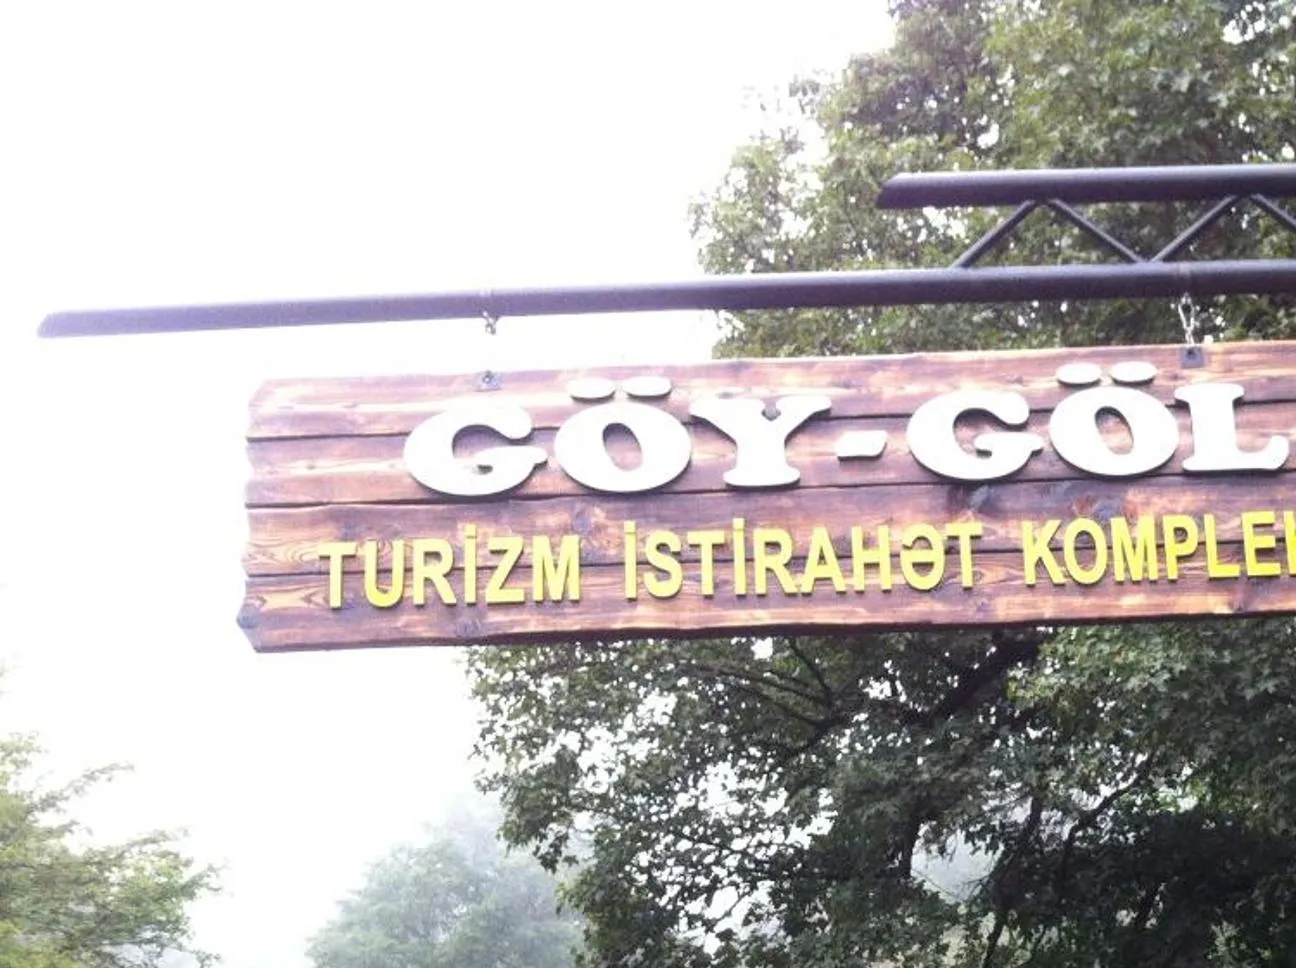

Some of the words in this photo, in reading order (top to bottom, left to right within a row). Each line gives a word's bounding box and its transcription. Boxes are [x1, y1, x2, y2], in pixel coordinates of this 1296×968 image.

[402, 361, 1291, 497] GÖY-GÖL
[319, 524, 582, 610] TURİZM
[624, 515, 984, 601] İSTİRAHƏT
